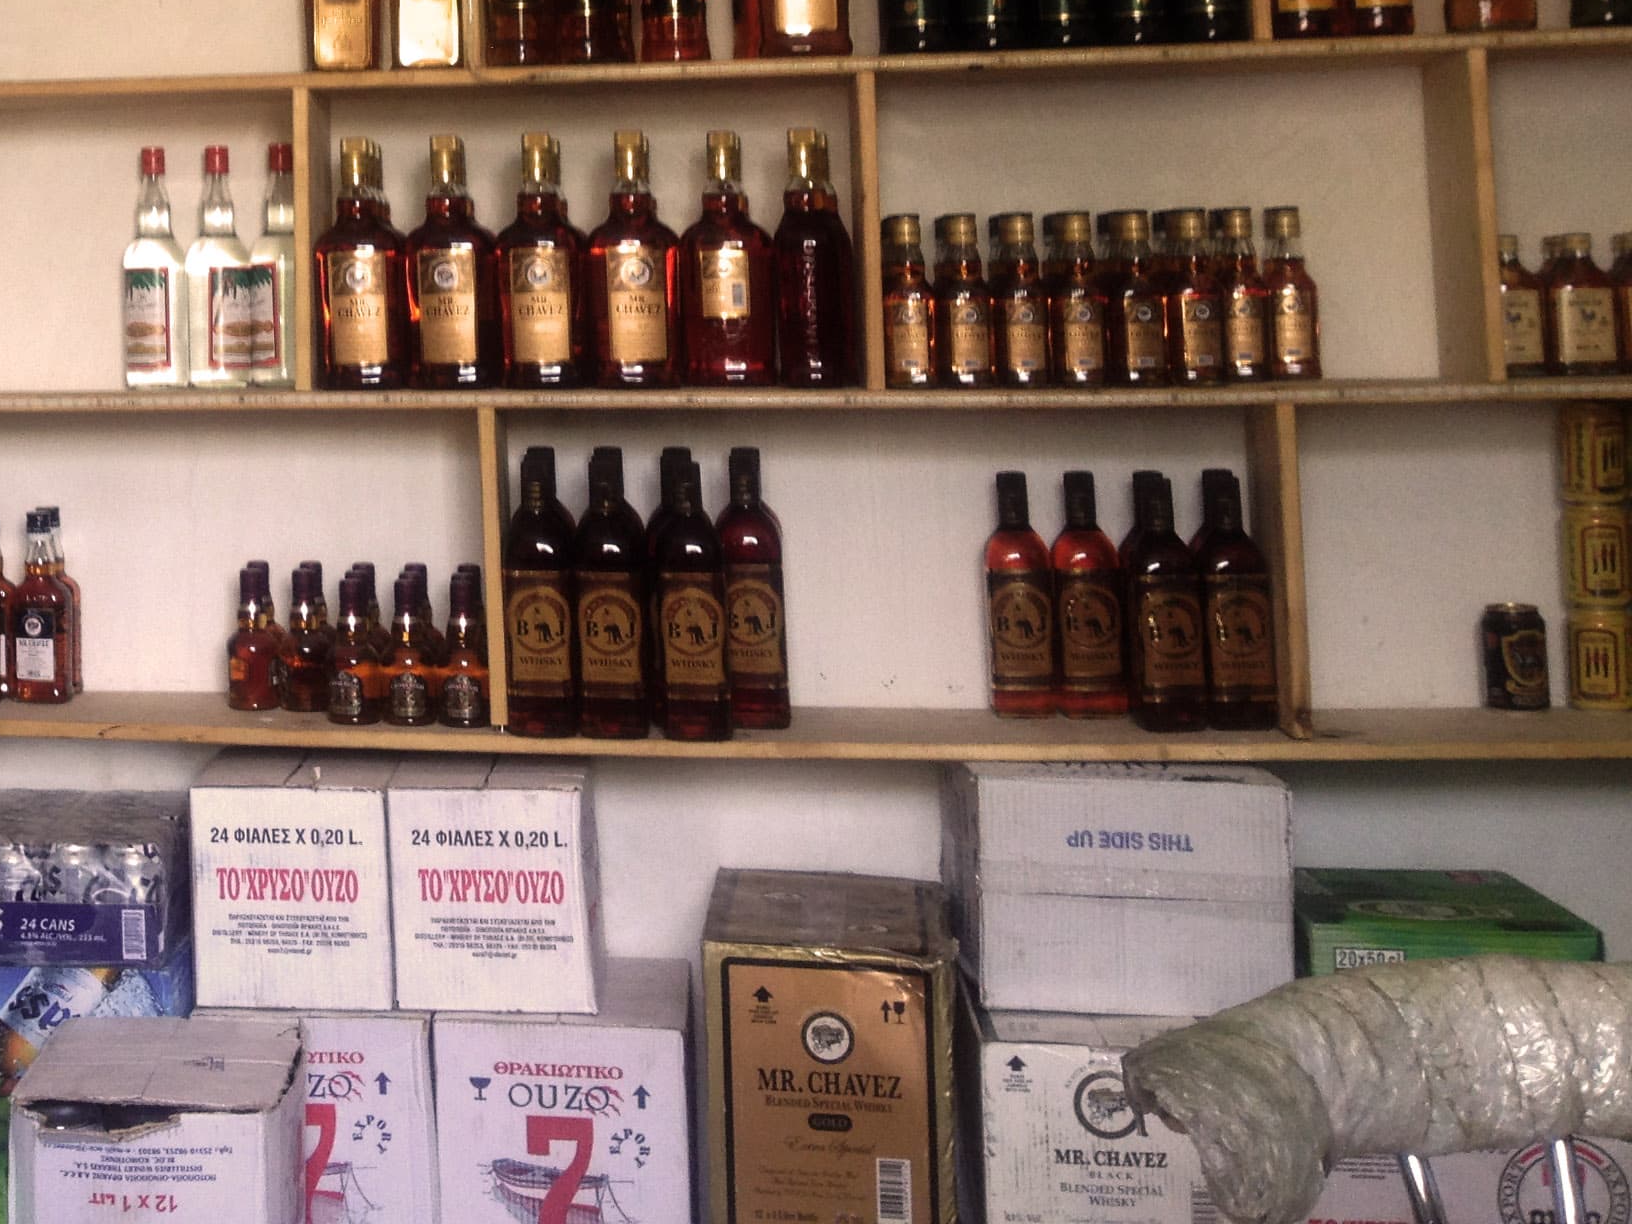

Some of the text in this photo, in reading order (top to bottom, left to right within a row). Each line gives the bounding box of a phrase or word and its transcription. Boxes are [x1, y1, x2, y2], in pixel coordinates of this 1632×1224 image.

[211, 828, 229, 844] 24
[234, 828, 291, 845] ΦΙΑΛΕΣ
[311, 829, 345, 847] 0,20
[412, 830, 430, 846] 24
[436, 830, 494, 848] ΦΙΑΛΕΣ
[515, 831, 549, 849] 0,20
[554, 832, 568, 848] L.
[1067, 829, 1194, 853] THIS SIDE UP
[20, 918, 76, 932] 24 CANS
[307, 1051, 365, 1065] ΩΤΙΚΟ
[493, 1061, 624, 1080] ΘΡΑΚΙΩΤΙΚΟ
[308, 1073, 353, 1099] ZO
[757, 1067, 903, 1100] MR. CHAVEZ
[508, 1082, 610, 1111] OUZO
[1054, 1149, 1169, 1169] MR. CHAVEZ
[526, 1115, 594, 1224] 7
[1059, 1182, 1164, 1196] BLENDED SPECIAL
[121, 1195, 131, 1212] 1
[155, 1194, 178, 1212] 12
[1088, 1194, 1137, 1207] WHISKY
